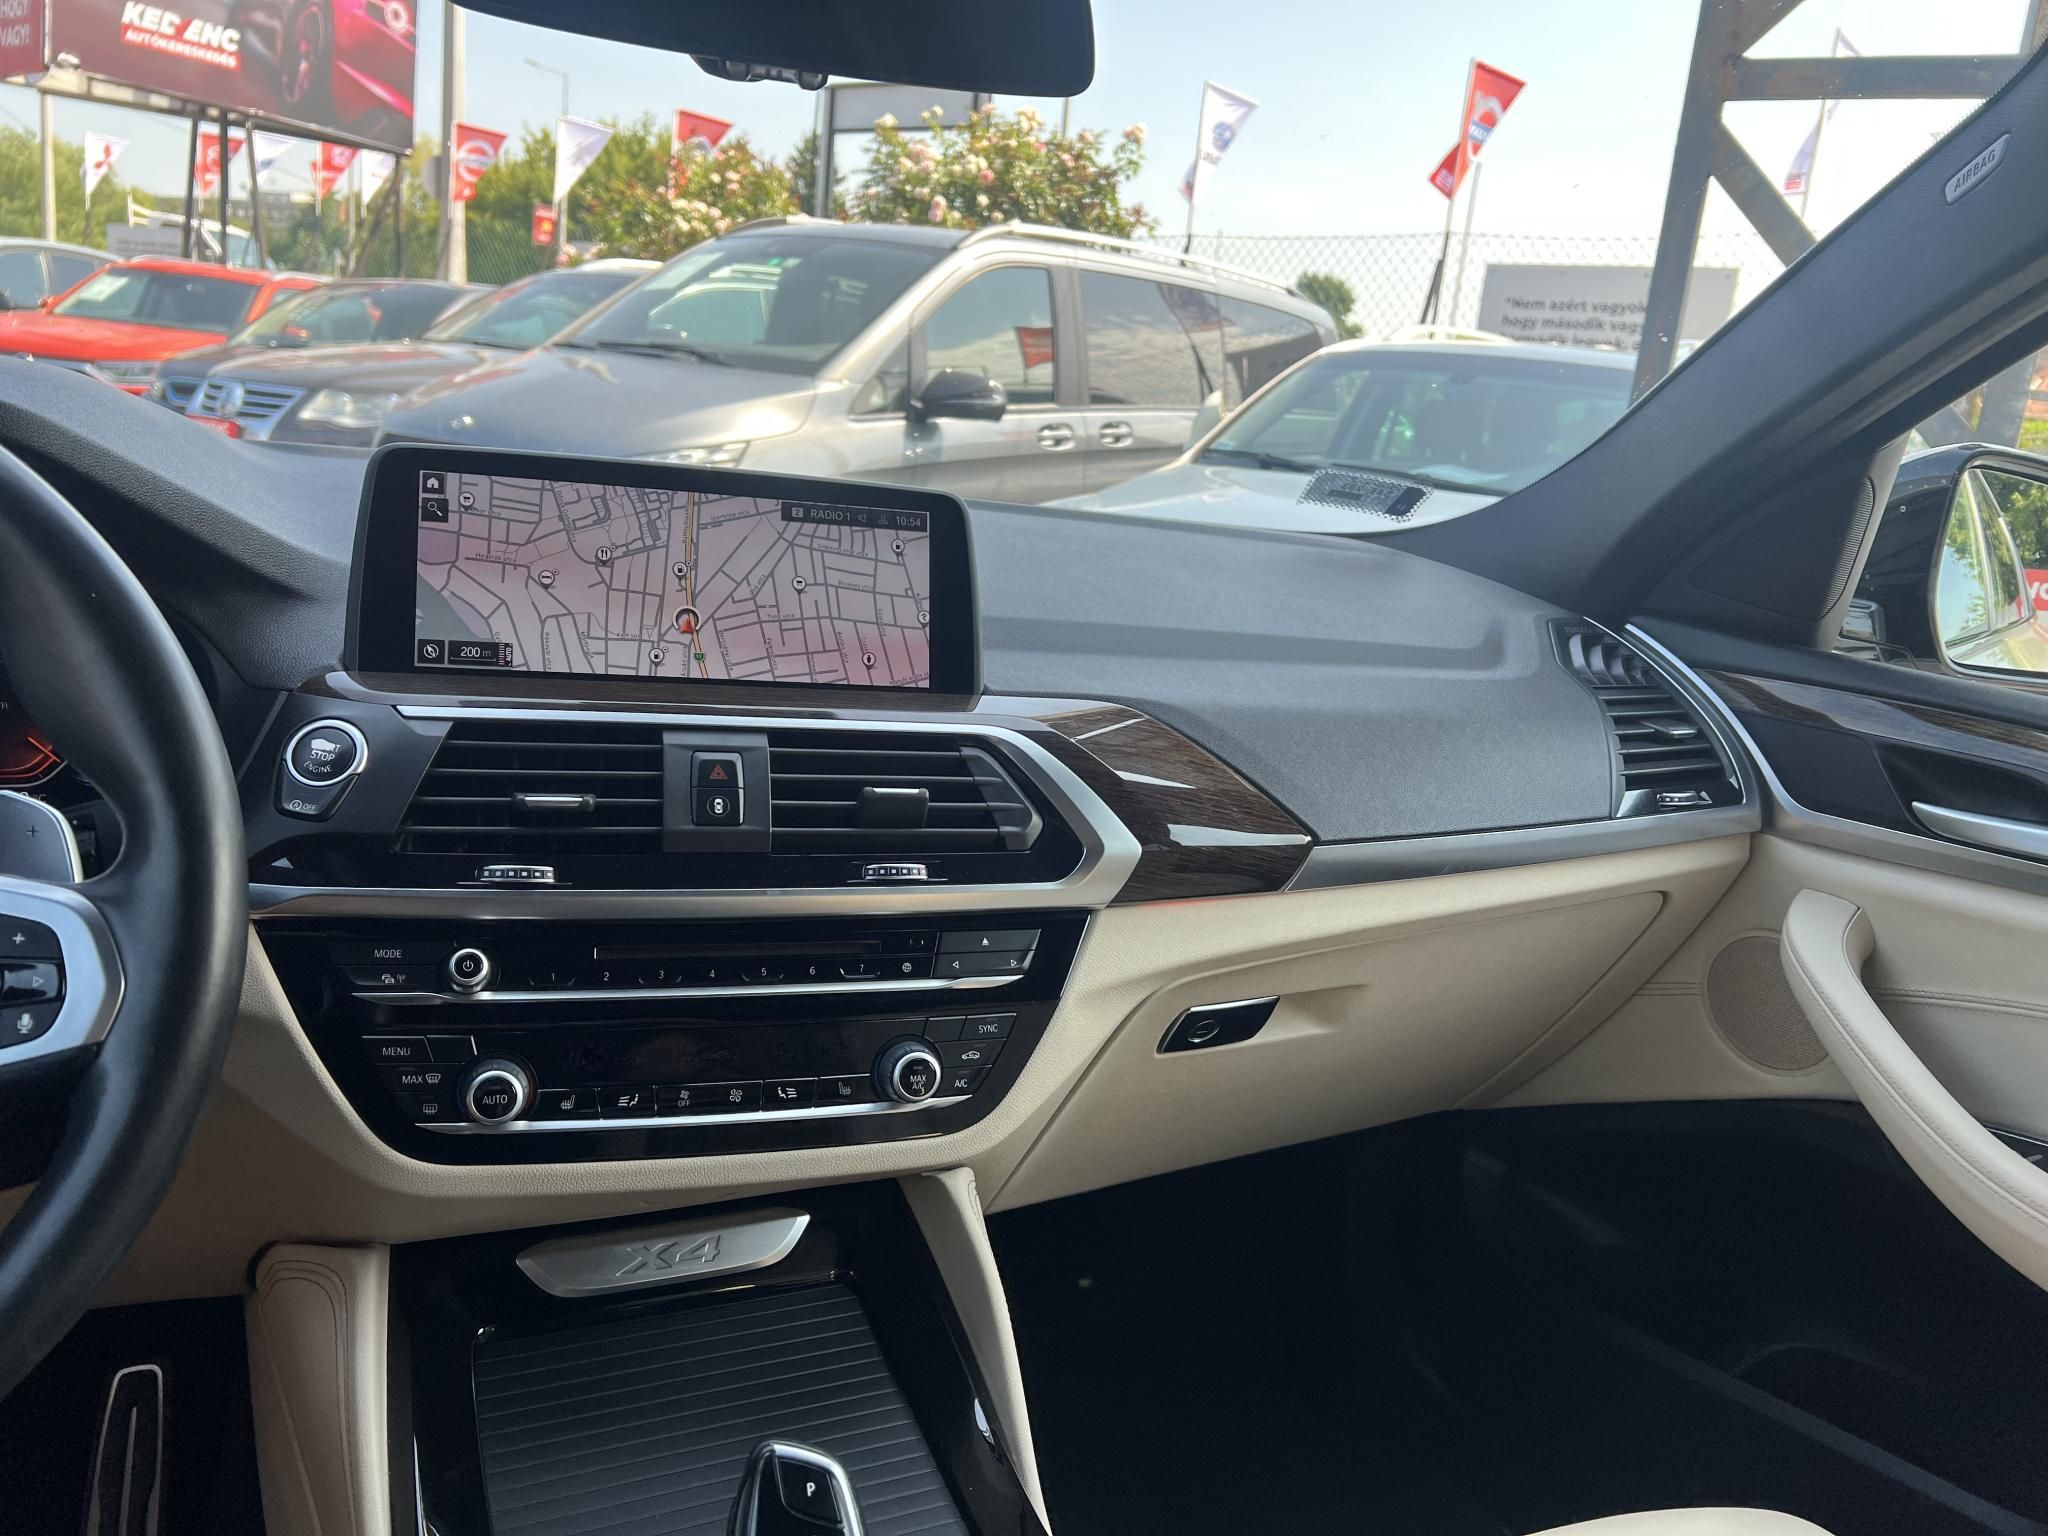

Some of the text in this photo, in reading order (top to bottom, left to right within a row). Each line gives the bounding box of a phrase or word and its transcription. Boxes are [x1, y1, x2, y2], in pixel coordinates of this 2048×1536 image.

[1953, 148, 1996, 193] AIRBAG
[810, 509, 843, 520] RADIO
[846, 512, 851, 521] 1
[895, 516, 921, 526] 10:54
[460, 646, 491, 657] 200 m
[310, 750, 335, 762] STOP
[303, 760, 332, 773] ENGINE
[374, 949, 402, 958] MODE
[551, 964, 864, 982] 1 2 3 4 5 6 7
[978, 1024, 998, 1033] SYNC
[382, 1047, 411, 1056] MENU
[402, 1075, 423, 1084] MAX
[910, 1074, 927, 1083] MAX
[954, 1079, 968, 1088] A/C
[482, 1094, 508, 1105] AUTO
[677, 1100, 690, 1108] OFF
[615, 1234, 721, 1276] X4
[806, 1482, 816, 1497] P
